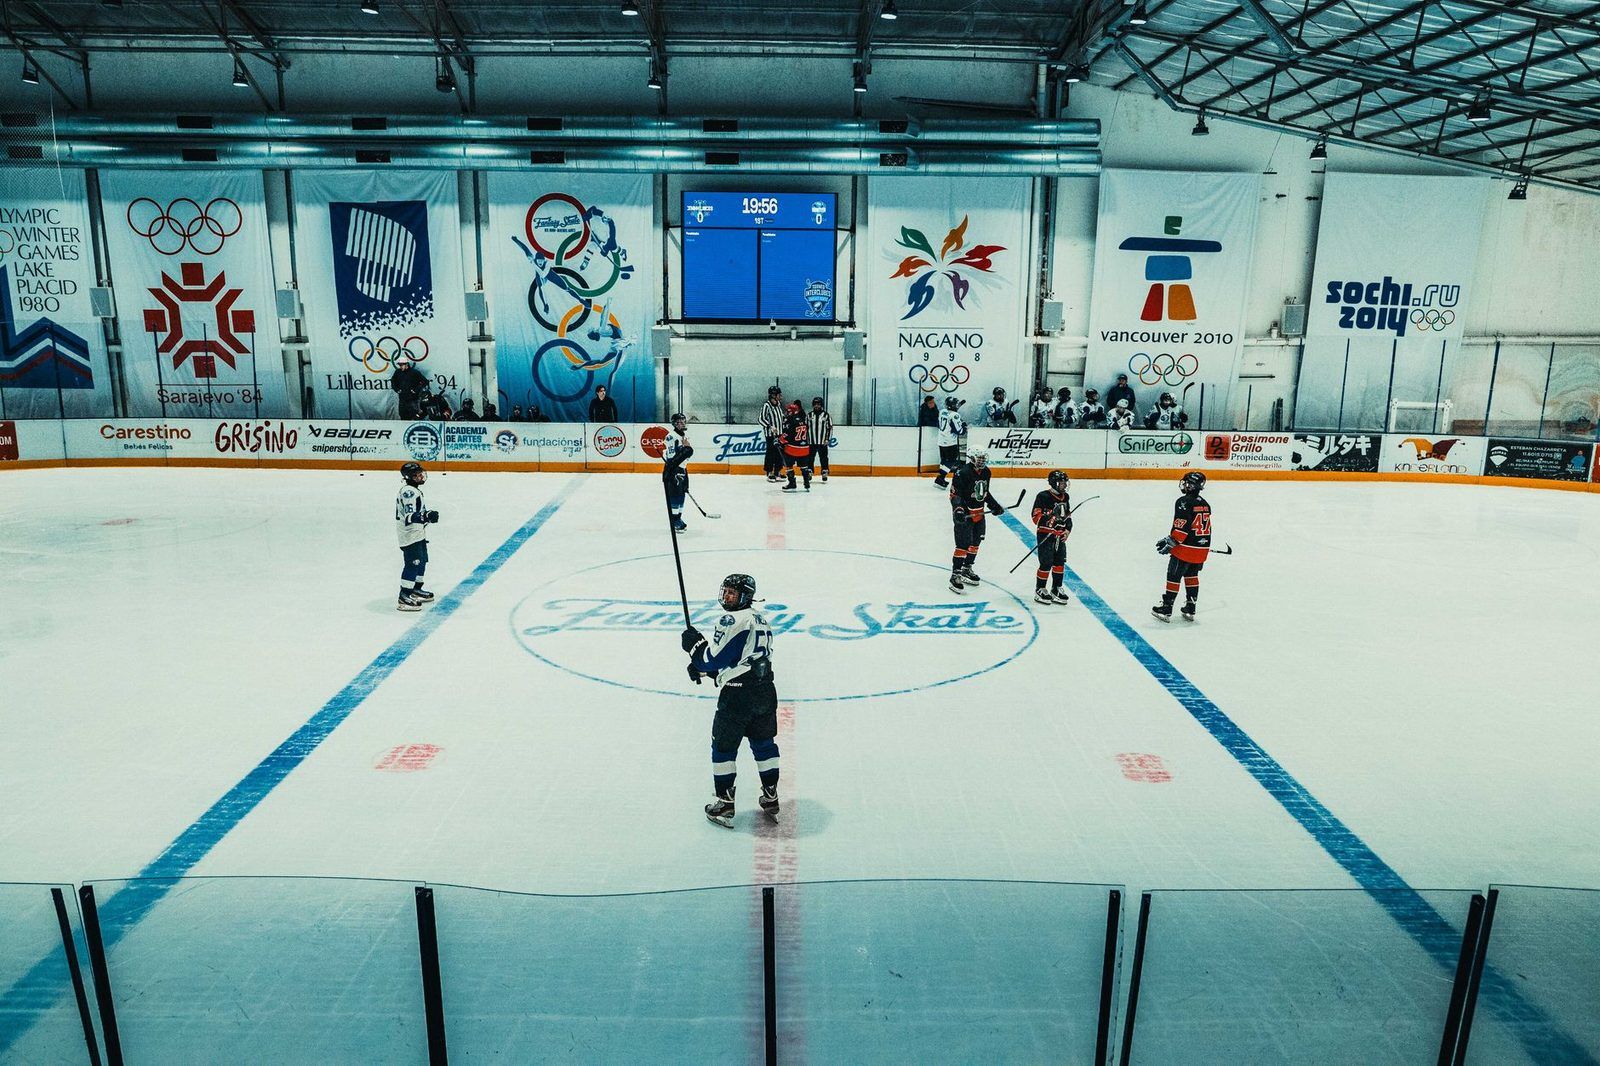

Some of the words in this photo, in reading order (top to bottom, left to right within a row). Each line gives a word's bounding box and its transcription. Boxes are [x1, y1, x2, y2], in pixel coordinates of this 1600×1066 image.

[742, 197, 778, 214] 19:56
[697, 211, 704, 223] 0
[815, 213, 823, 225] 0
[13, 227, 80, 242] WINTER
[18, 244, 79, 260] GAMES
[15, 262, 54, 277] LAKE
[17, 280, 77, 295] PLACID
[1326, 276, 1460, 308] sochi.ru
[19, 297, 59, 312] 1980
[899, 333, 983, 348] NAGANO
[1100, 329, 1188, 345] vancouver
[1194, 333, 1233, 345] 2010
[157, 389, 234, 407] Sarajevo
[100, 424, 191, 440] Carestino
[446, 427, 487, 435] ACADEMIA
[1232, 434, 1289, 443] Desimone
[457, 435, 482, 443] ARTES
[597, 436, 623, 445] Funny
[713, 430, 767, 461] Fanta
[988, 438, 1051, 449] HOCKEY
[1231, 443, 1263, 452] Grillo
[1231, 453, 1283, 462] Propiedades
[1191, 513, 1211, 536] 47
[809, 601, 1025, 639] Skate
